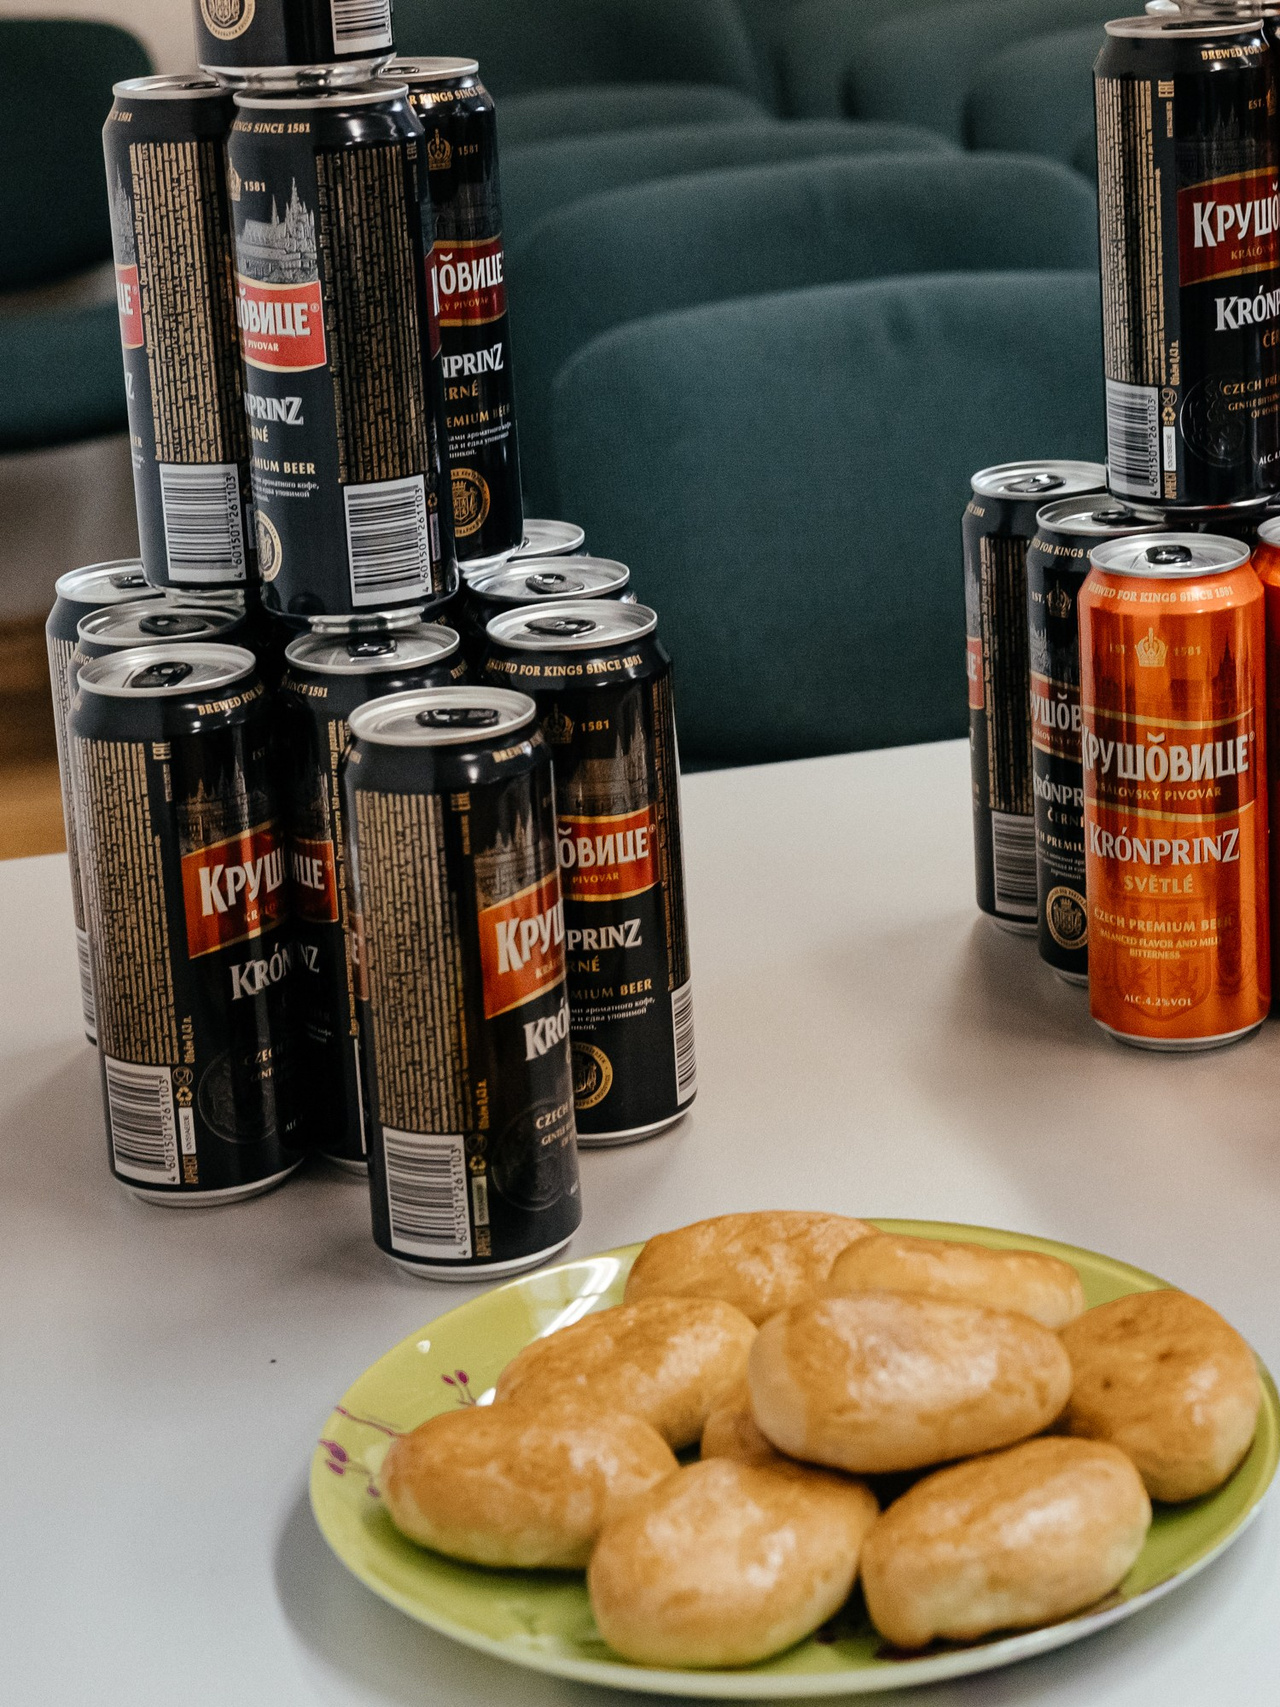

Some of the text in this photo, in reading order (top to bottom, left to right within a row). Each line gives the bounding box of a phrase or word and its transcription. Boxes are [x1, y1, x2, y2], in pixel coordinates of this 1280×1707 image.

[1200, 46, 1243, 61] BREWED
[420, 91, 453, 104] KINGS
[253, 122, 311, 134] SINCE 1581
[458, 143, 479, 156] 1581
[243, 180, 267, 192] 1581
[1223, 378, 1262, 396] CZECH
[283, 461, 317, 475] BEER
[1053, 543, 1084, 559] KINGS
[1117, 590, 1137, 602] FOR
[1139, 591, 1177, 603] KINGS
[1179, 589, 1214, 602] SINCE
[519, 653, 643, 677] FOR KINGS SINCE 1581
[308, 685, 329, 698] 1581
[198, 693, 242, 716] BREWED
[581, 718, 610, 732] 1581
[1165, 786, 1222, 801] PIVOVAR
[1089, 820, 1240, 866] KRÓNPRINZ
[572, 870, 620, 884] PIVOVAR
[1123, 873, 1194, 895] SVĚTLÉ
[1093, 905, 1125, 928] CZECH
[1128, 918, 1197, 933] PREMIUM
[1139, 937, 1174, 949] FLAVOR
[1175, 937, 1198, 949] AND
[1129, 948, 1181, 960] BITTERNESS
[619, 977, 653, 997] BEER
